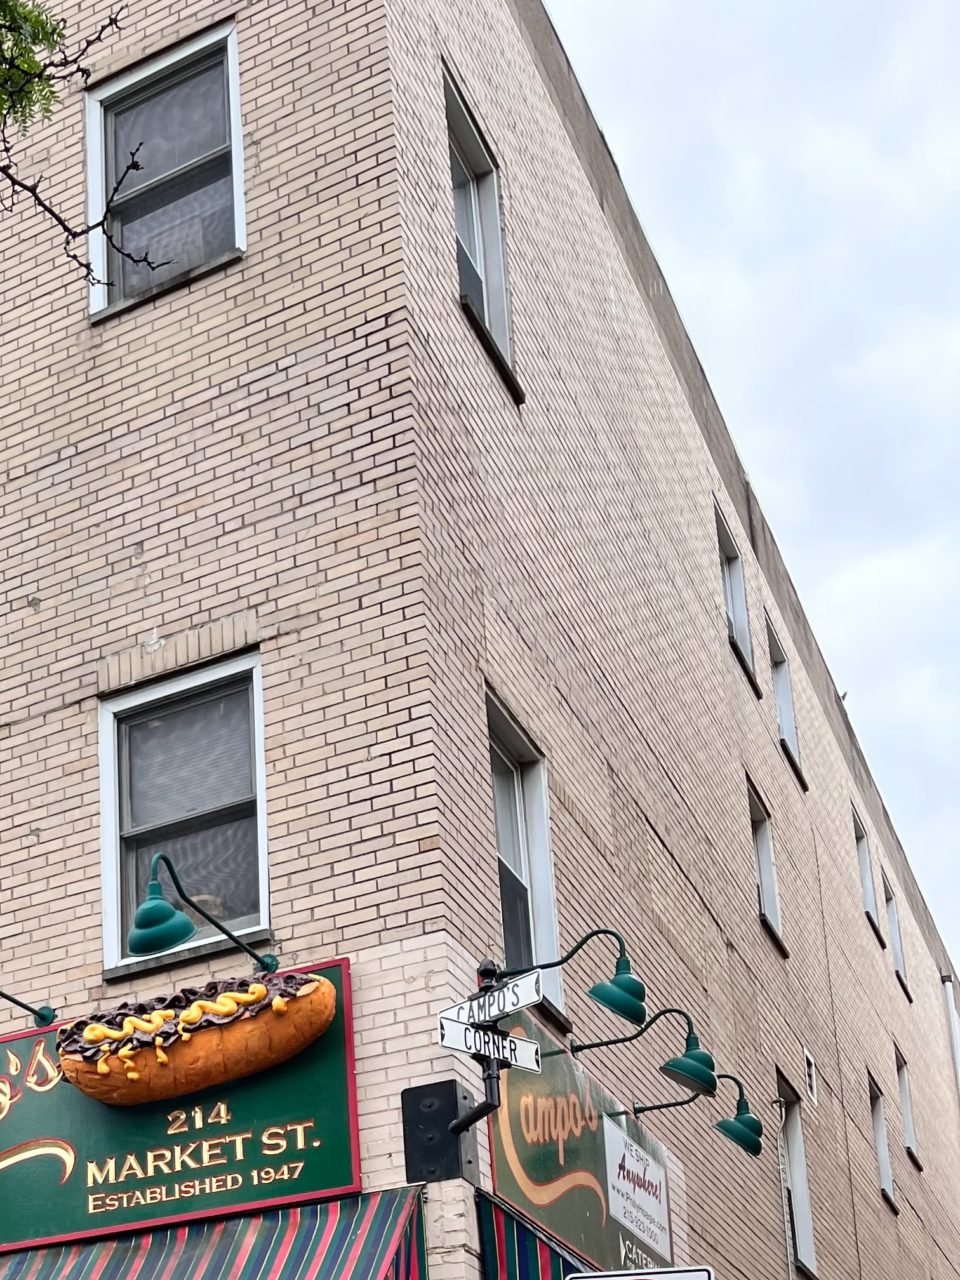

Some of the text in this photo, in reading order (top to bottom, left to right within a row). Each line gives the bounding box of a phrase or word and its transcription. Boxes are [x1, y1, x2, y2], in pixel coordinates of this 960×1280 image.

[457, 984, 520, 1023] CAMPO'S
[464, 1027, 518, 1064] CORNER
[166, 1101, 232, 1135] 214
[86, 1119, 321, 1188] MARKET ST.
[87, 1162, 304, 1214] ESTABLISHED 1947
